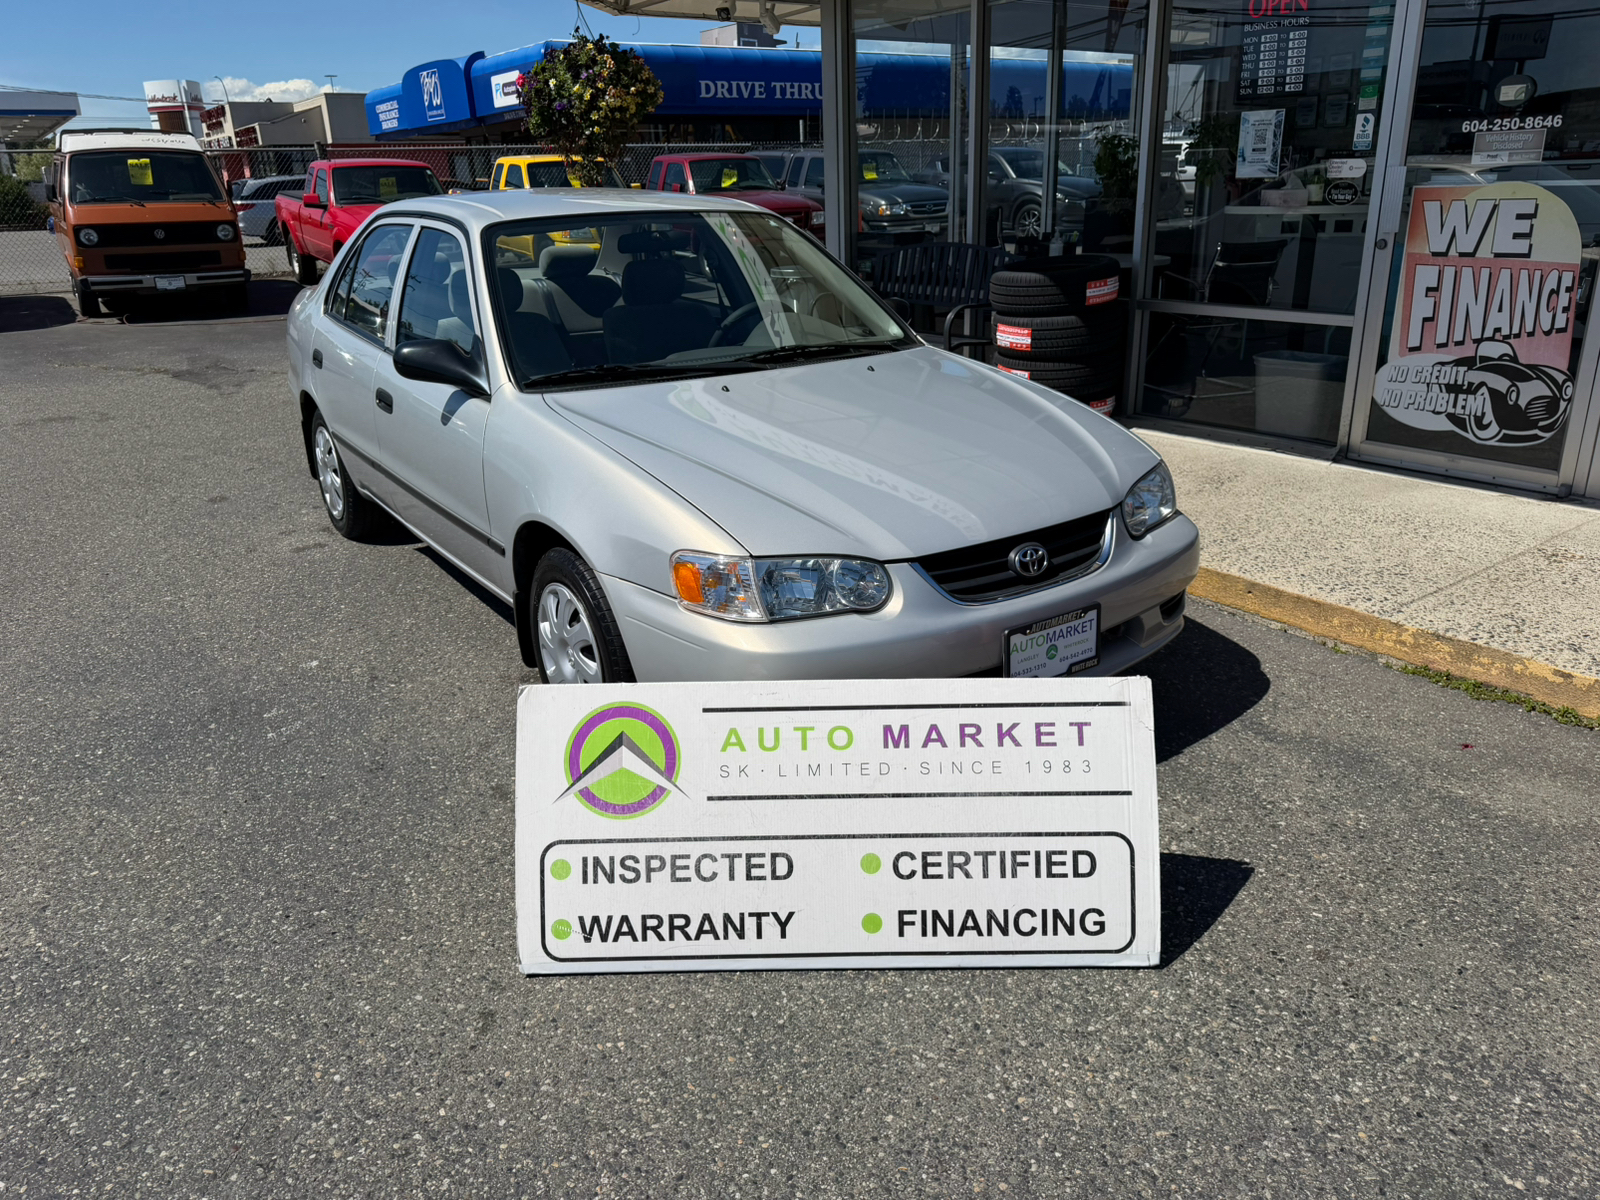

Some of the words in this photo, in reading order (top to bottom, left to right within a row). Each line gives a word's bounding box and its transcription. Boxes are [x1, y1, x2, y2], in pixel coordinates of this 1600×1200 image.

[1249, 0, 1308, 18] OPEN
[1244, 21, 1278, 32] BUSINESS
[1281, 16, 1310, 28] HOURS
[699, 80, 766, 98] DRIVE
[771, 82, 823, 100] THRU
[1462, 114, 1563, 133] 604-250-8646
[1486, 134, 1509, 142] Vehicle
[1509, 133, 1534, 142] History
[1493, 141, 1523, 150] Disclosed
[1423, 198, 1538, 257] WE
[1406, 264, 1574, 352] FINANCE
[1388, 365, 1409, 383] NO
[1411, 366, 1468, 389] CREDIT,
[1380, 388, 1402, 408] NO
[1404, 390, 1486, 416] PROBLEM
[1031, 610, 1082, 633] AUTOMARKET
[1010, 618, 1094, 656] AUTOMARKET
[1017, 653, 1040, 664] LANGLEY
[1059, 648, 1093, 662] 604-542-4970
[1072, 661, 1086, 673] WHITE
[1086, 658, 1098, 668] ROCK
[720, 726, 855, 752] AUTO
[883, 722, 1092, 749] MARKET
[720, 764, 750, 778] SK
[778, 762, 891, 777] LIMITED
[920, 760, 1003, 776] SINCE
[1025, 759, 1093, 774] 1983
[581, 852, 794, 884] INSPECTED
[892, 850, 1098, 880] CERTIFIED
[578, 911, 796, 943] WARRANTY
[898, 908, 1106, 938] FINANCING
